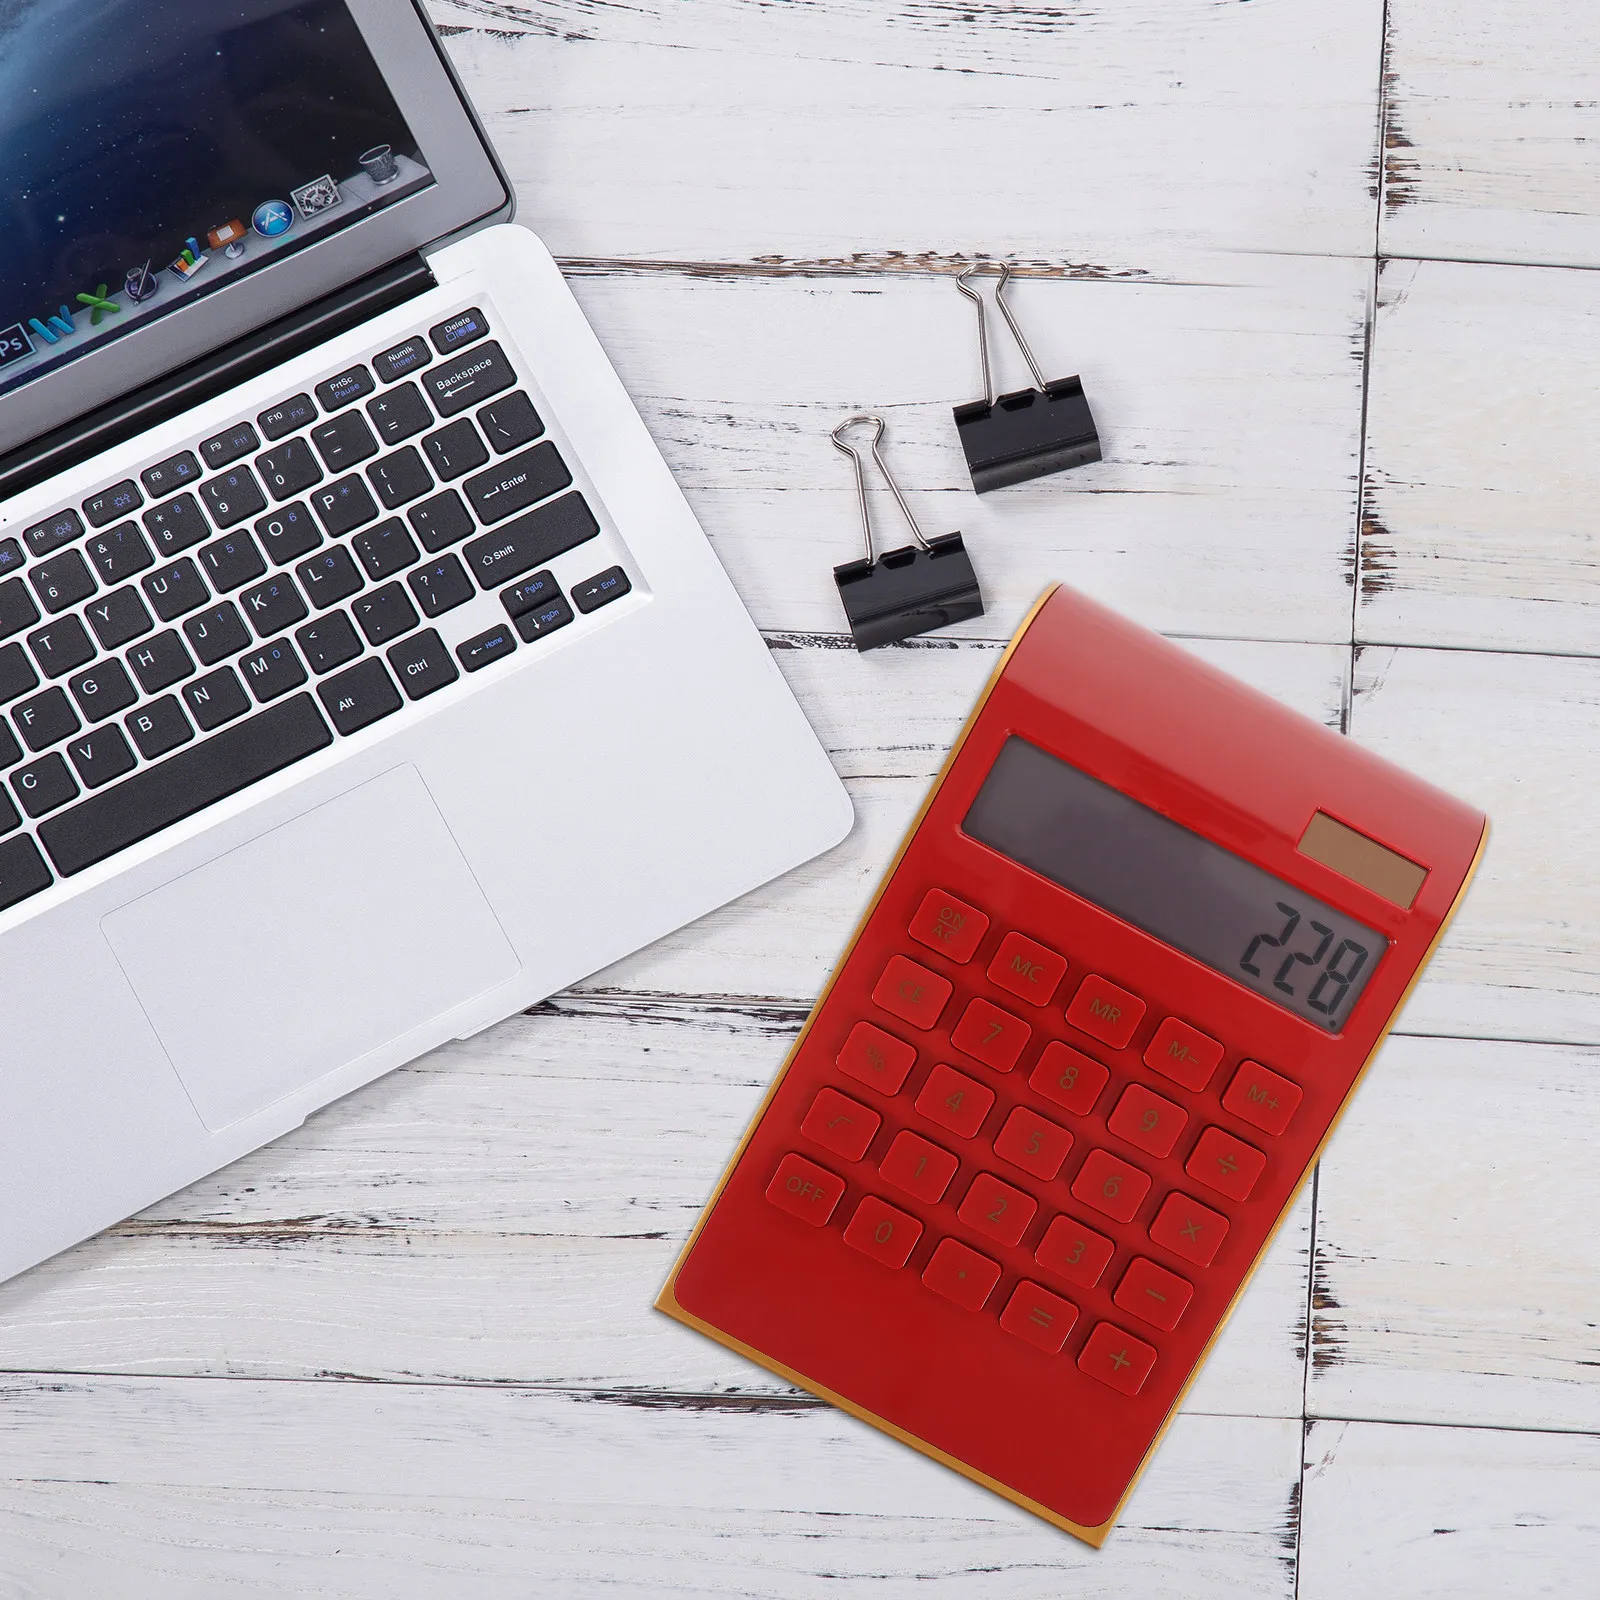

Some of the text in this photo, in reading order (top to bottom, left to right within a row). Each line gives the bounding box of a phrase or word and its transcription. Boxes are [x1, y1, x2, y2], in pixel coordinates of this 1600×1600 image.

[445, 316, 470, 334] Delete
[0, 337, 23, 357] Ps
[392, 353, 416, 370] Insert
[436, 358, 492, 391] Backspace
[329, 376, 353, 392] PrtSc
[334, 382, 360, 398] Pause
[267, 412, 283, 424] F10
[291, 407, 305, 419] F12
[210, 441, 222, 452] F9
[234, 436, 248, 448] F11
[150, 471, 162, 481] F8
[229, 476, 238, 485] 9
[275, 474, 285, 485] 0
[501, 472, 527, 491] Enter
[92, 500, 104, 510] F7
[173, 504, 182, 513] 8
[219, 502, 228, 513] 9
[322, 496, 334, 510] P
[289, 512, 296, 522] 6
[33, 530, 45, 540] F6
[116, 533, 123, 542] 7
[163, 530, 173, 540] 8
[98, 544, 108, 554] &
[226, 544, 234, 553] 5
[493, 545, 515, 561] Shift
[105, 558, 113, 570] 7
[326, 558, 335, 568] 3
[173, 571, 181, 580] 4
[308, 568, 323, 582] L
[421, 576, 430, 586] ?
[152, 578, 168, 594] U
[270, 586, 280, 596] 2
[524, 580, 543, 595] PgUp
[600, 578, 616, 590] End
[48, 587, 58, 597] 6
[251, 594, 267, 610] K
[97, 606, 109, 621] Y
[217, 613, 224, 622] 1
[541, 608, 560, 623] PgDn
[198, 623, 208, 638] J
[39, 636, 52, 651] T
[484, 636, 503, 649] Home
[138, 650, 155, 666] H
[250, 657, 269, 675] M
[407, 659, 428, 676] Ctrl
[82, 679, 98, 694] G
[193, 687, 210, 703] N
[338, 698, 355, 712] Alt
[22, 708, 36, 725] F
[138, 716, 153, 732] B
[79, 744, 92, 759] V
[22, 773, 37, 789] C
[939, 907, 966, 928] ON
[932, 924, 956, 944] AC
[1010, 954, 1044, 983] MC
[899, 980, 926, 1004] CE
[1089, 998, 1122, 1025] MR
[982, 1022, 1003, 1044] 7
[866, 1045, 885, 1071] %
[1059, 1066, 1079, 1090] 8
[945, 1091, 965, 1113] 4
[1247, 1084, 1280, 1110] M+
[1139, 1109, 1159, 1132] 9
[1024, 1131, 1045, 1155] 5
[914, 1156, 927, 1179] 1
[786, 1175, 825, 1202] OFF
[1102, 1176, 1124, 1198] 6
[987, 1200, 1008, 1224] 2
[1066, 1240, 1086, 1264] 3
